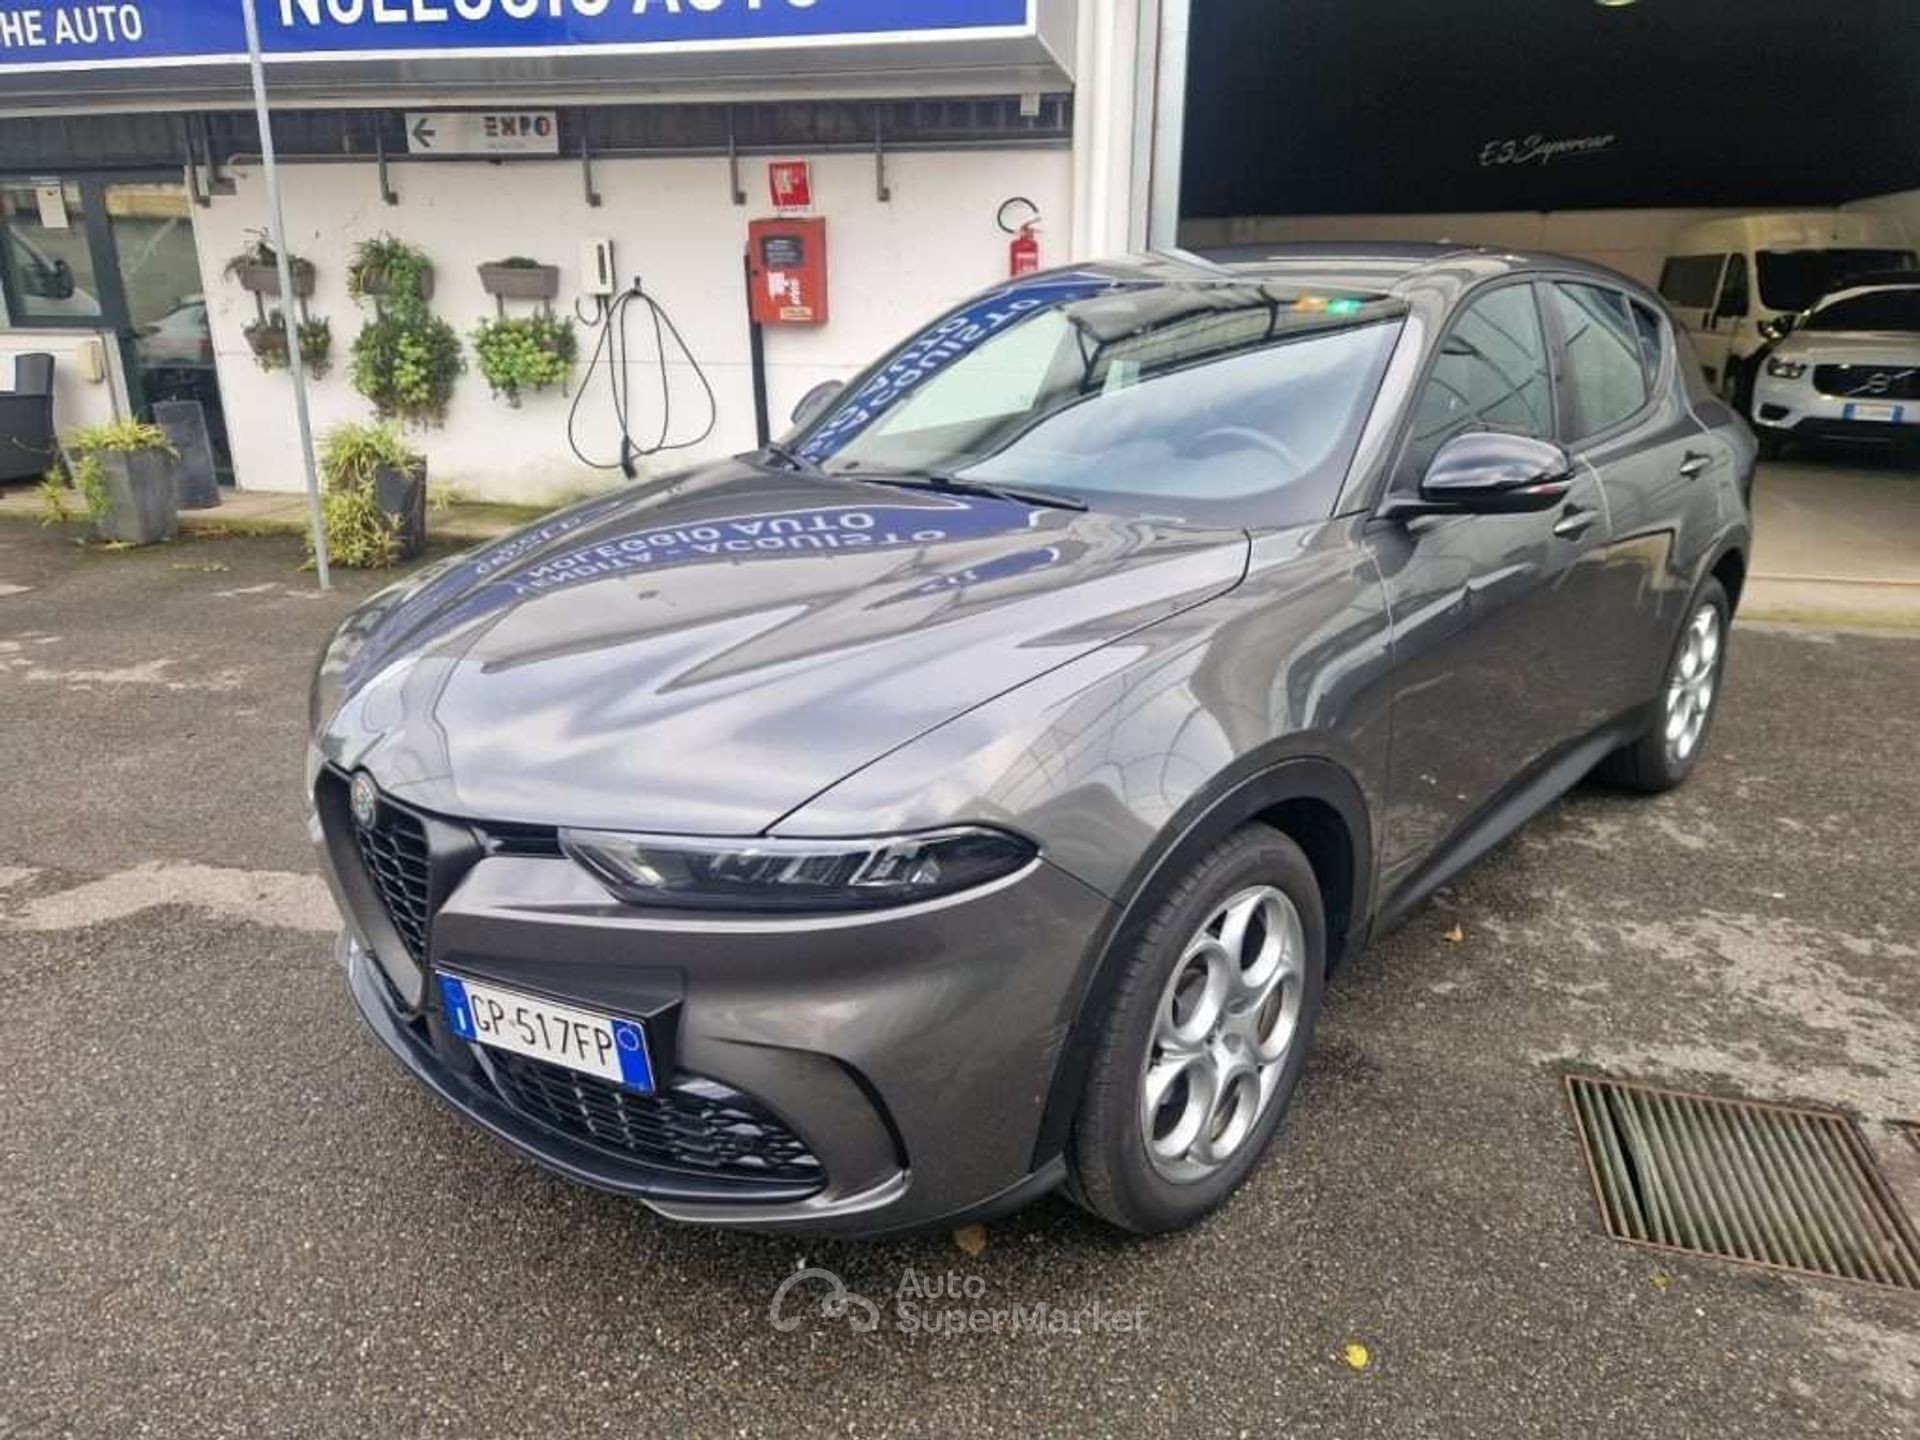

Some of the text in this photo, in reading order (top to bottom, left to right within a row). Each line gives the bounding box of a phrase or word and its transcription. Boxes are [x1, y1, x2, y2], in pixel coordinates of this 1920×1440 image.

[56, 4, 142, 44] AUTO
[484, 116, 550, 136] EXPO
[470, 994, 504, 1036] GP
[516, 1007, 613, 1066] 517FP
